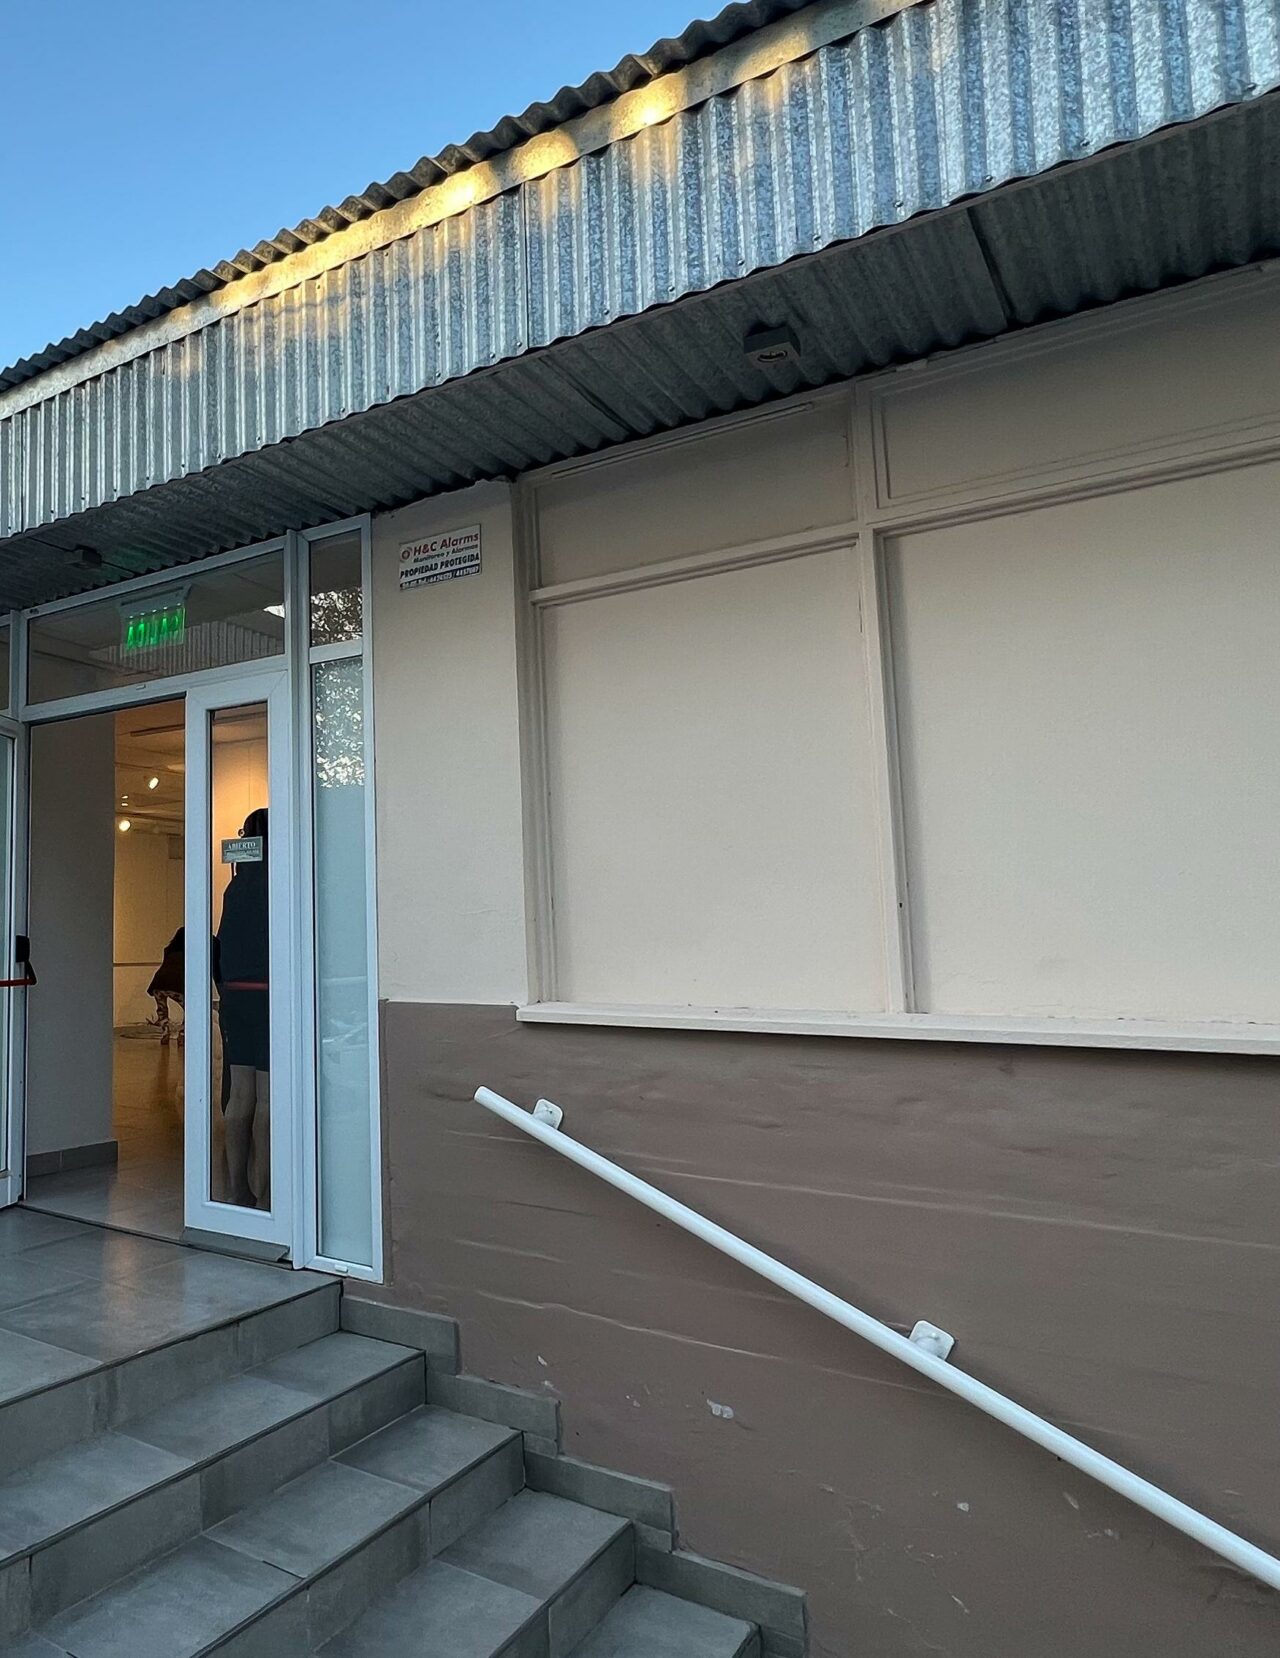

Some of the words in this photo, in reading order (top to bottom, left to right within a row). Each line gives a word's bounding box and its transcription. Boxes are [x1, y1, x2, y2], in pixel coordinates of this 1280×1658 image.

[413, 541, 438, 556] H&C
[440, 533, 479, 549] Alarms
[400, 564, 439, 579] PROPIEDAD
[440, 552, 480, 569] PROTEGIDA
[228, 841, 256, 849] ABIERTO
